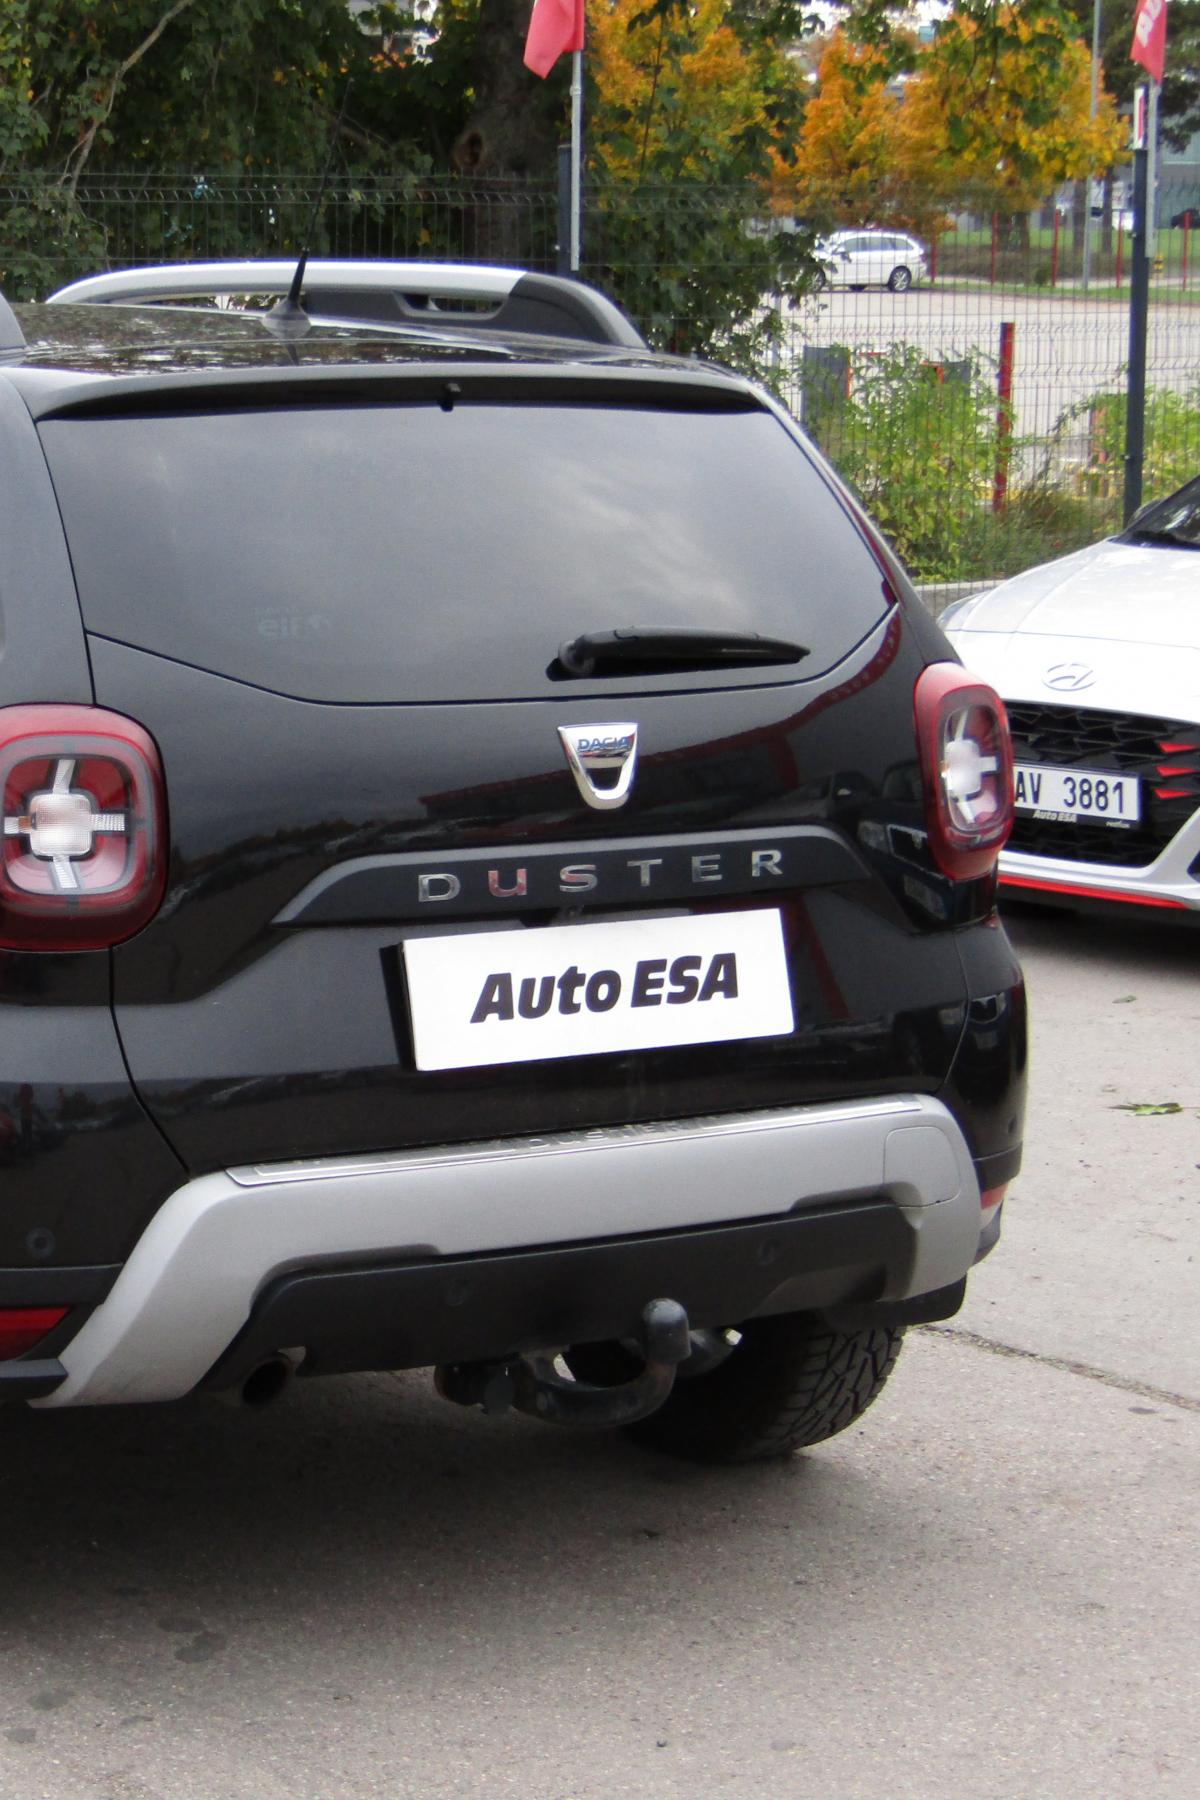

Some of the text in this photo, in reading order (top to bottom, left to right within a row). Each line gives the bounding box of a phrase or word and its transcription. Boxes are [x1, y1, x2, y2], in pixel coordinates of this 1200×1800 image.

[577, 735, 629, 751] DACIA
[1063, 776, 1123, 814] 3881
[417, 849, 784, 902] DUSTER
[470, 952, 738, 1024] Auto ESA
